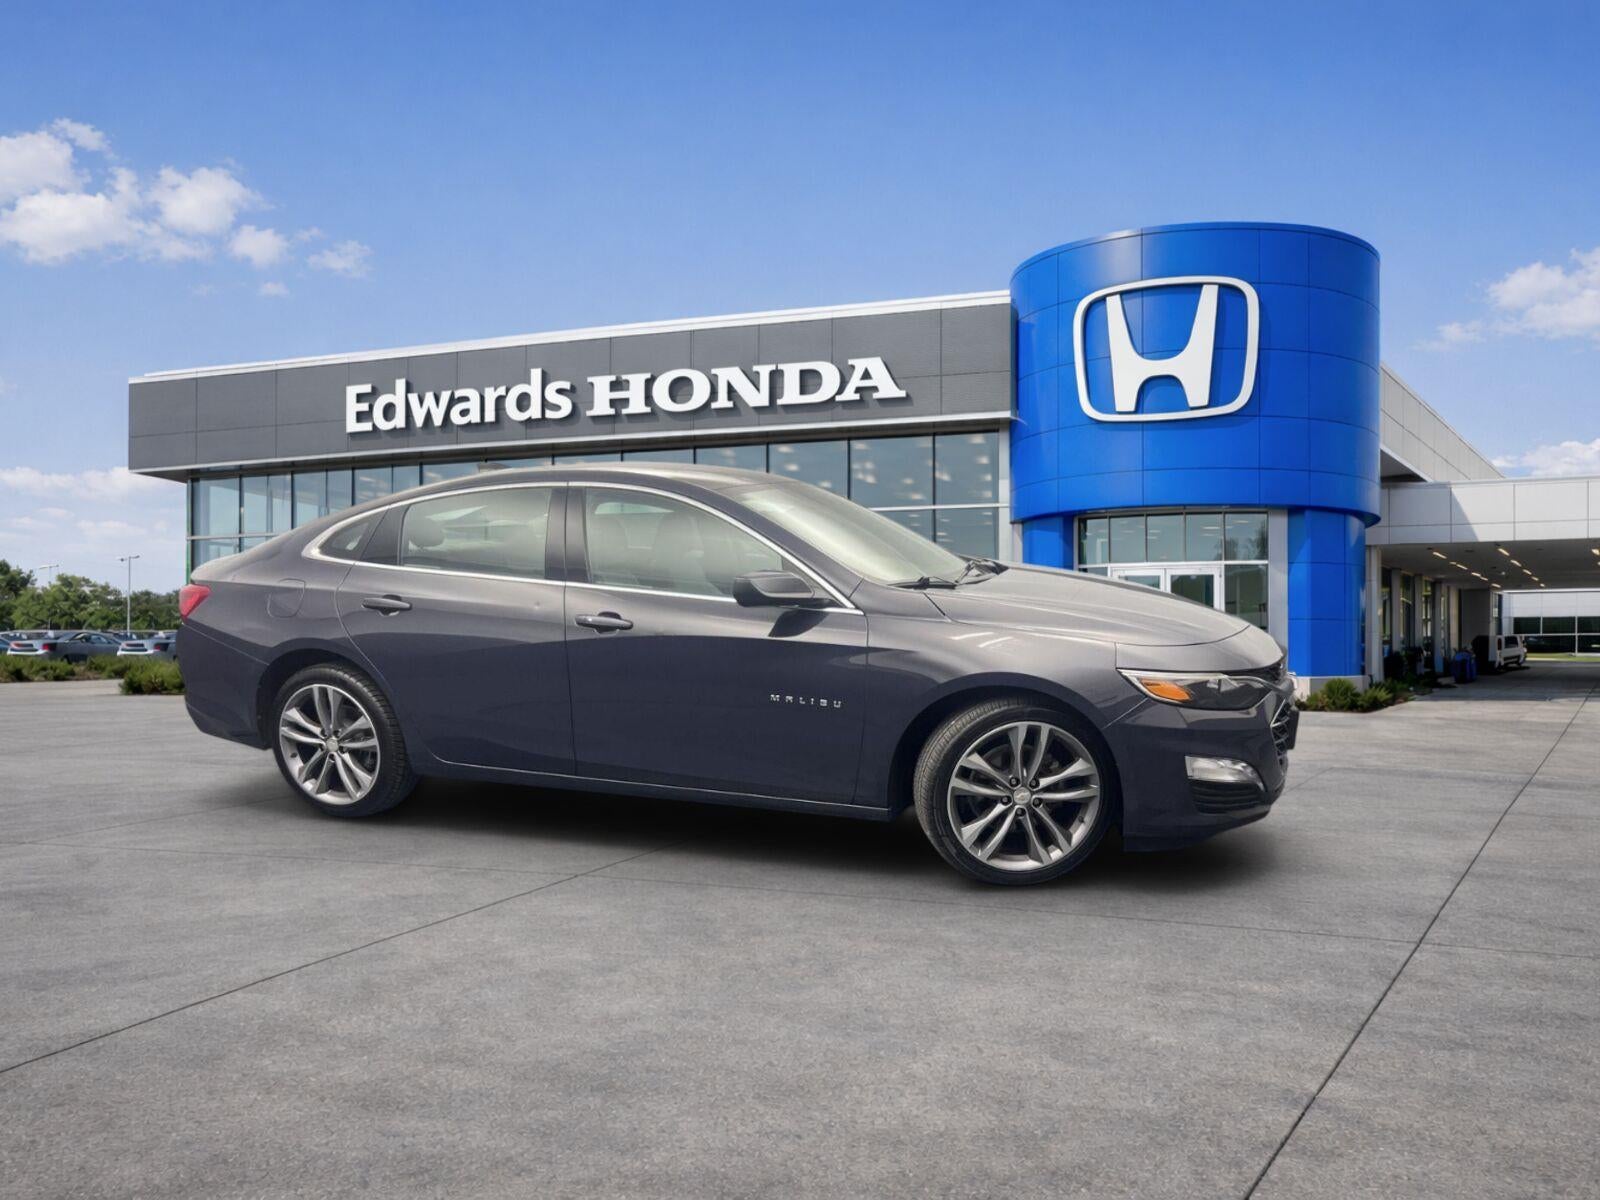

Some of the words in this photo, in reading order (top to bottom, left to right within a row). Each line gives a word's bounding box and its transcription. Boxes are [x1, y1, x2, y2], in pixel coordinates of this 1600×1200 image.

[345, 367, 573, 433] Edwards
[585, 356, 907, 417] HONDA
[770, 693, 843, 709] MALIBU
